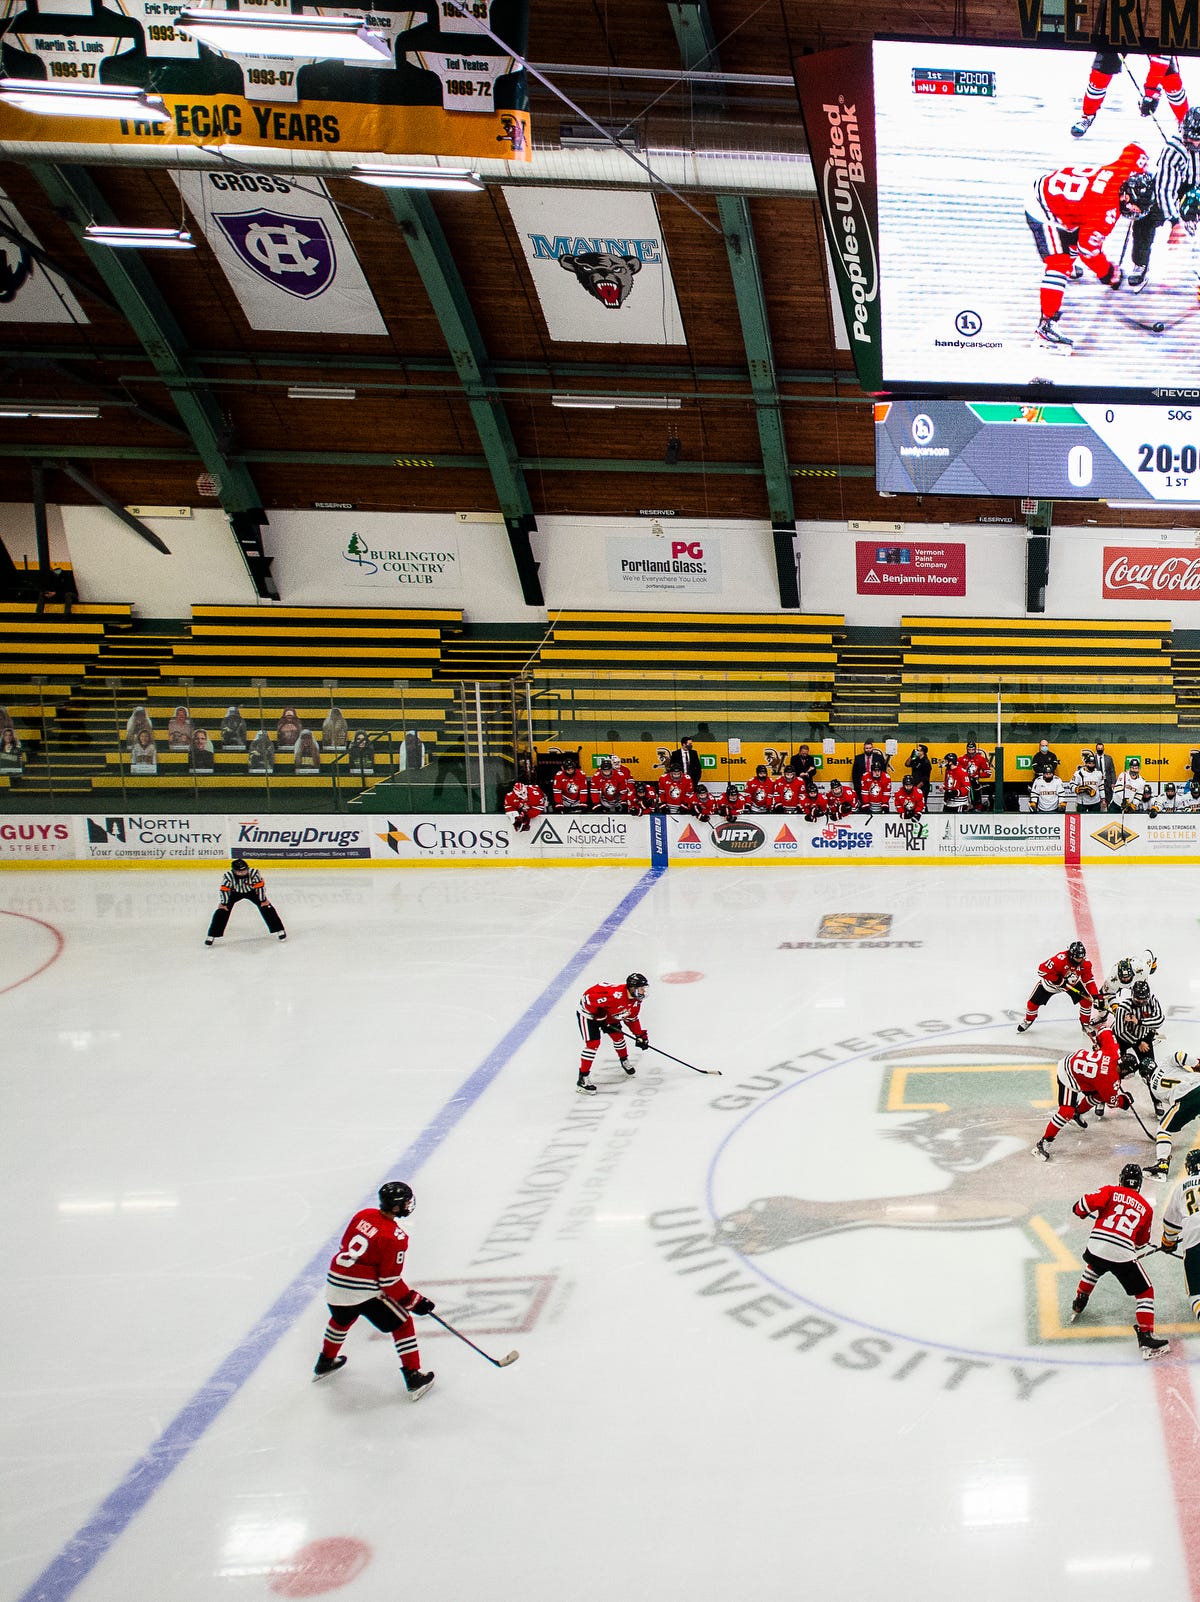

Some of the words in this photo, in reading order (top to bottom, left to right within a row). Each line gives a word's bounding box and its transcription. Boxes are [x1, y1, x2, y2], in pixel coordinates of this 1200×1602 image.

[145, 3, 161, 15] Eric
[35, 38, 66, 52] Martin
[82, 41, 104, 53] Louis
[49, 62, 96, 78] 1993-97
[445, 58, 458, 70] Ted
[461, 59, 489, 71] Yeates
[247, 68, 294, 86] 1993-97
[960, 72, 988, 84] 20:00
[446, 79, 492, 96] 1969-72
[175, 104, 241, 137] ECAC
[253, 107, 340, 143] YEARS
[842, 103, 865, 183] Bank
[823, 103, 854, 211] United
[209, 173, 291, 194] CROSS
[528, 233, 662, 264] MAINE
[935, 339, 1004, 349] handycars.com
[1160, 388, 1200, 397] NEVCO
[1105, 410, 1114, 422] 0
[1167, 410, 1192, 421] SOG
[1068, 446, 1093, 487] 0
[1176, 478, 1188, 487] ST
[370, 551, 455, 561] BURLINGTON
[672, 541, 703, 559] PG
[915, 549, 944, 557] Vermont
[383, 562, 445, 573] COUNTRY
[621, 560, 670, 572] Portland
[915, 561, 948, 569] Company
[399, 574, 433, 584] CLUB
[642, 575, 677, 583] Everywhere
[883, 574, 925, 585] Benjamin
[927, 575, 957, 584] Moore
[702, 757, 716, 767] TD
[721, 757, 747, 765] Bank
[827, 757, 852, 765] Bank
[1017, 758, 1031, 767] TD
[129, 818, 190, 829] NORTH
[567, 819, 627, 834] Acadia
[960, 824, 990, 835] UVM
[994, 824, 1060, 835] Bookstore
[0, 825, 69, 840] GUYS
[139, 832, 222, 844] COUNTRY
[413, 822, 509, 849] CROSS
[655, 817, 663, 855] BAUER
[718, 829, 758, 842] JIFFY
[838, 829, 872, 840] Price
[567, 834, 626, 844] INSURANCE
[731, 840, 758, 849] mart
[811, 837, 872, 850] Chopper
[90, 846, 111, 857] Your
[115, 848, 165, 858] community
[169, 846, 195, 856] credit
[197, 847, 224, 856] union
[939, 844, 1062, 853] http://uvmbookstore.uvm.edu
[777, 941, 852, 950] ARMY
[856, 941, 923, 949] ROTC
[469, 1139, 590, 1267] VERMONT
[1102, 1204, 1141, 1237] 12
[396, 1251, 405, 1264] 8
[647, 1206, 1059, 1401] UNIVERSITY
